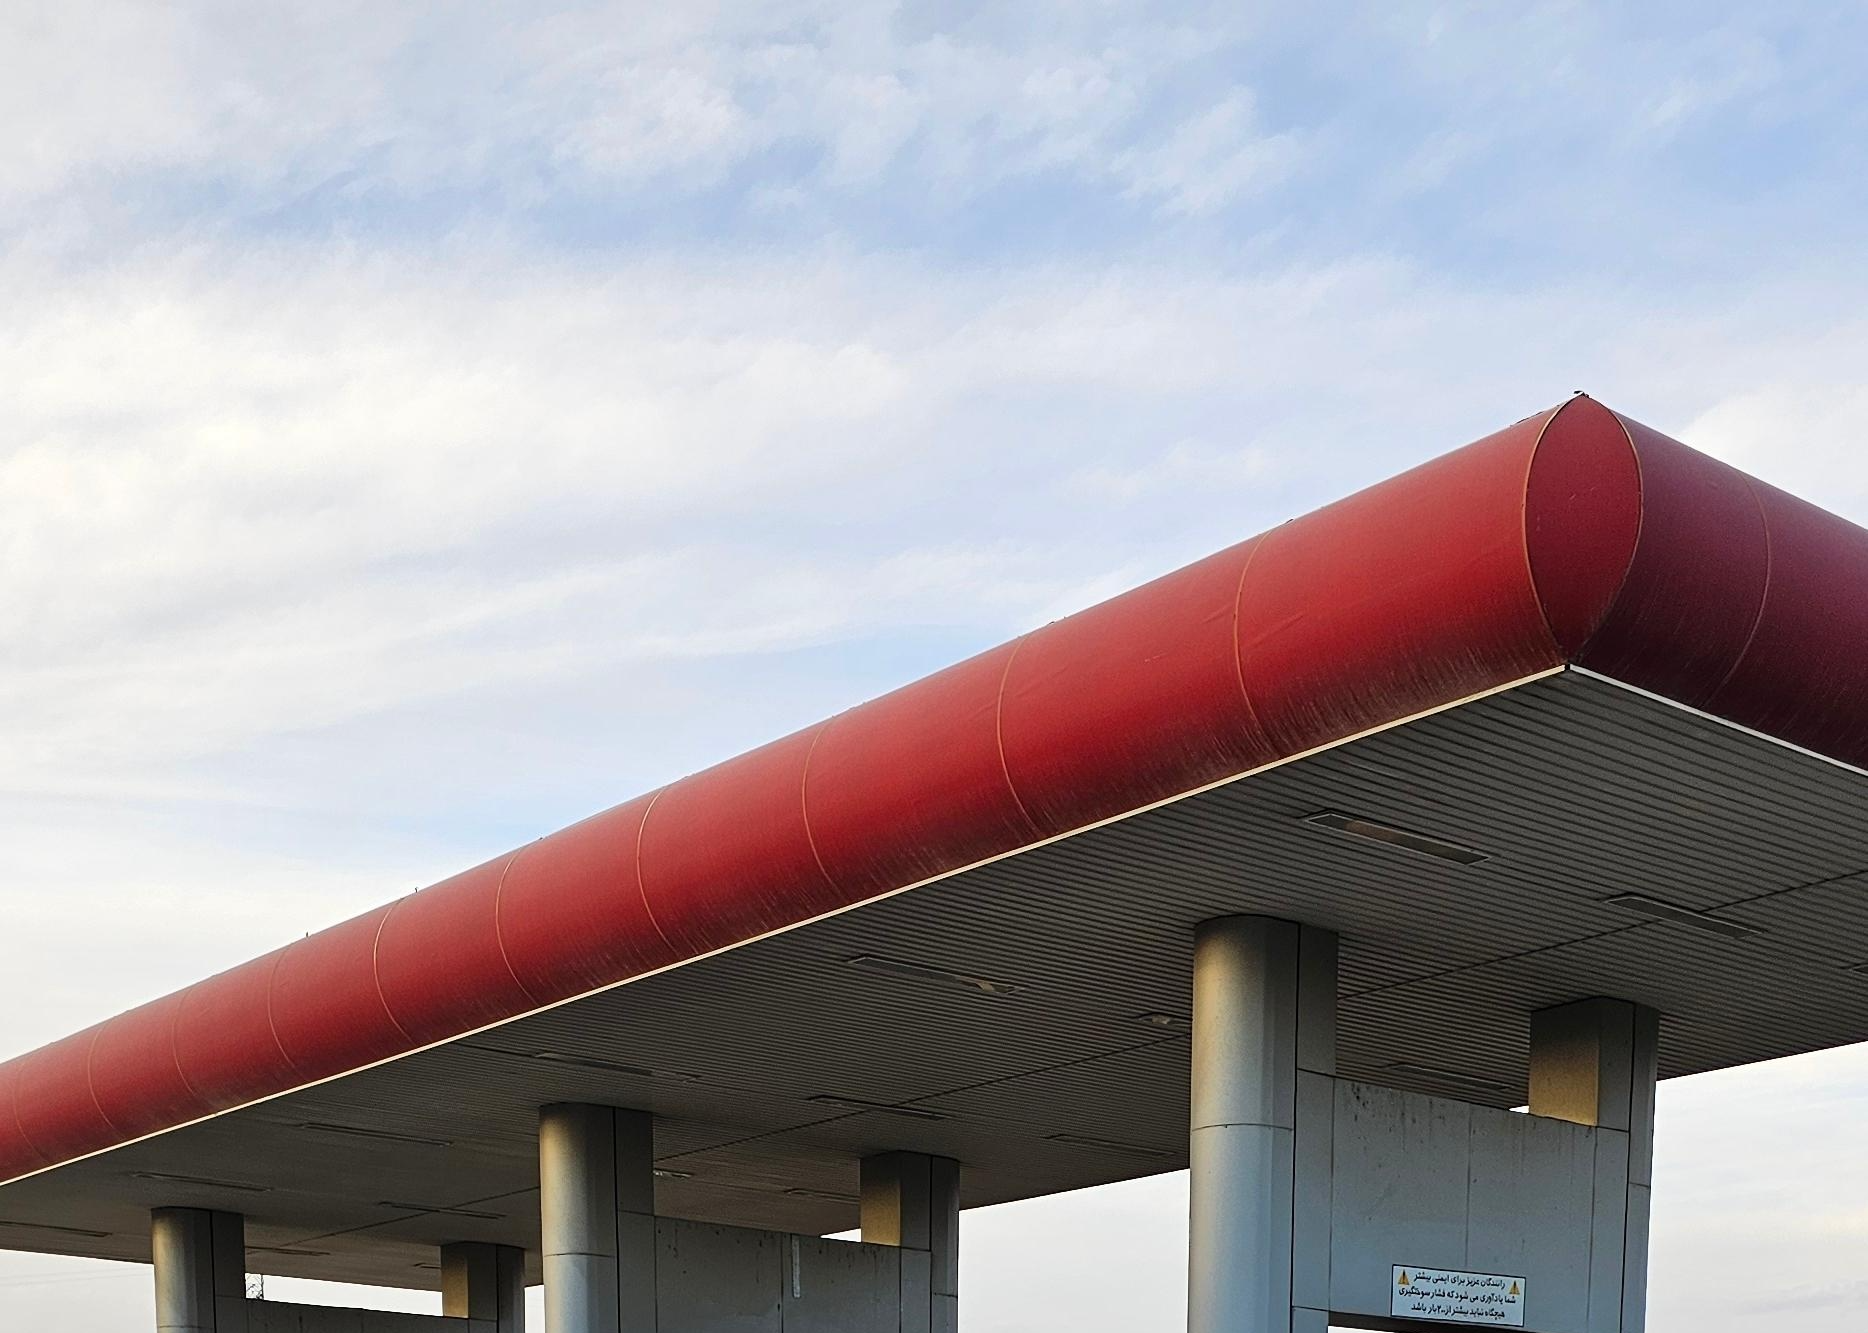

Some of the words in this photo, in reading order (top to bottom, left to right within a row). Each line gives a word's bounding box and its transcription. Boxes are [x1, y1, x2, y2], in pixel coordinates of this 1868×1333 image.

[1414, 1272, 1431, 1283] بیشتر
[1432, 1274, 1450, 1284] ایمنی
[1450, 1275, 1465, 1286] برای
[1466, 1277, 1480, 1287] عزیز
[1480, 1278, 1505, 1290] رانندگان
[1399, 1286, 1430, 1299] سوختگیری
[1430, 1289, 1445, 1299] فشار
[1446, 1290, 1455, 1298] که
[1455, 1291, 1468, 1303] شود
[1470, 1295, 1478, 1303] می
[1480, 1293, 1503, 1305] یادآوری
[1504, 1295, 1516, 1304] شما
[1411, 1302, 1426, 1314] باشد
[1427, 1304, 1437, 1315] بار
[1445, 1305, 1451, 1315] از
[1451, 1306, 1468, 1317] بیشتر
[1470, 1308, 1484, 1318] نباید
[1485, 1308, 1505, 1320] هیچگاه
